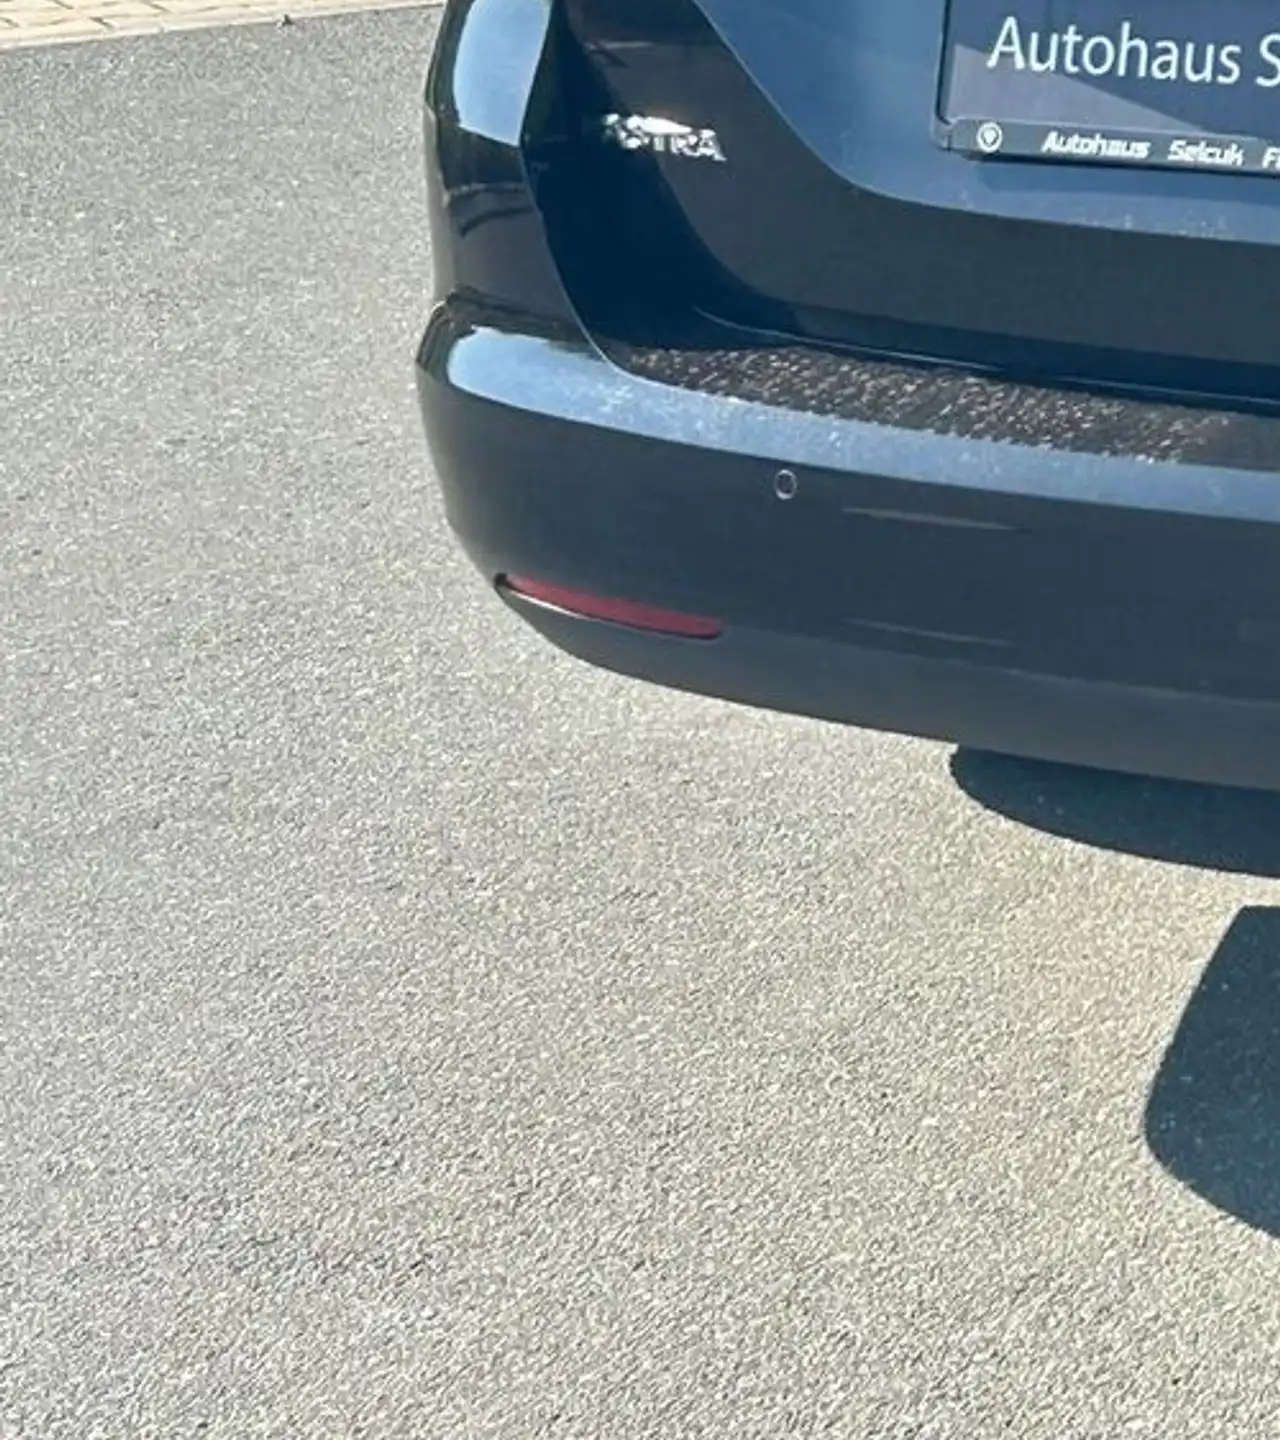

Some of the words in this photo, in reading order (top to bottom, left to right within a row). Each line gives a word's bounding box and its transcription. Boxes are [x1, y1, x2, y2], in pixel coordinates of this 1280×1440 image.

[986, 15, 1242, 85] Autohaus
[1041, 130, 1151, 160] Autohaus
[1166, 139, 1246, 168] Selcuk
